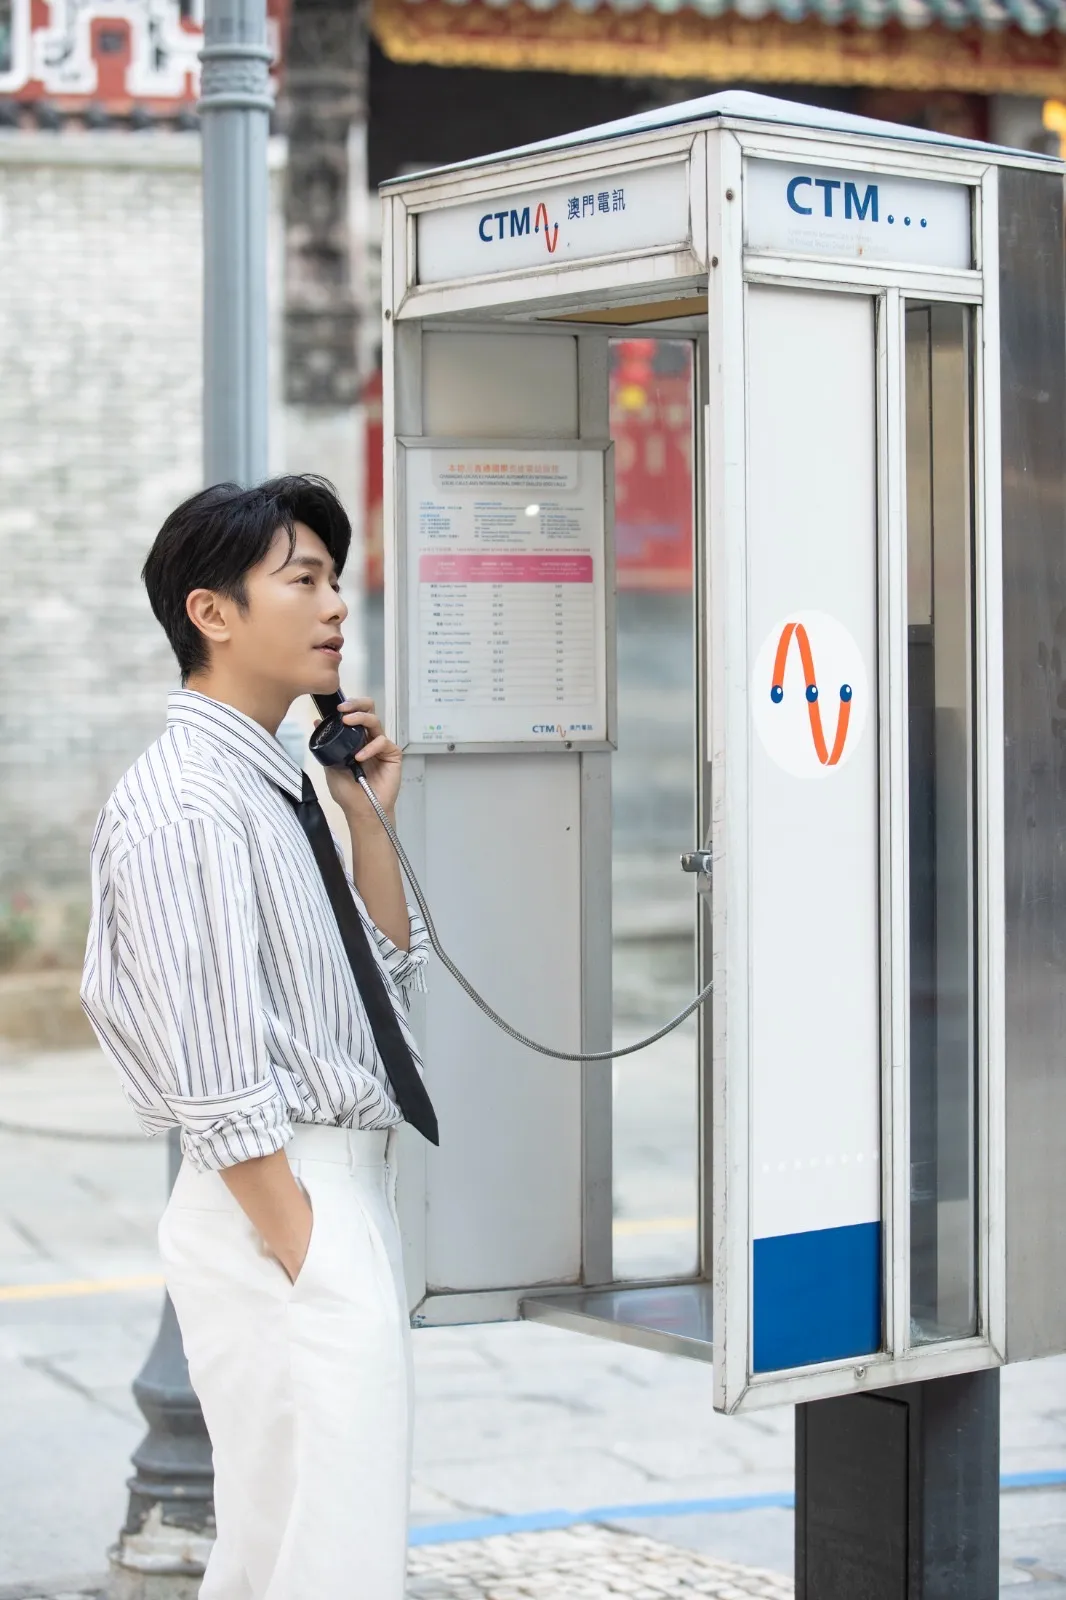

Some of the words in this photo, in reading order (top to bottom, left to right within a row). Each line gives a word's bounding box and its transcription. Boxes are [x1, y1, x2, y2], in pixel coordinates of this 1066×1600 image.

[567, 188, 626, 220] 澳門電訊
[479, 207, 530, 242] CTM
[532, 725, 555, 733] CTM
